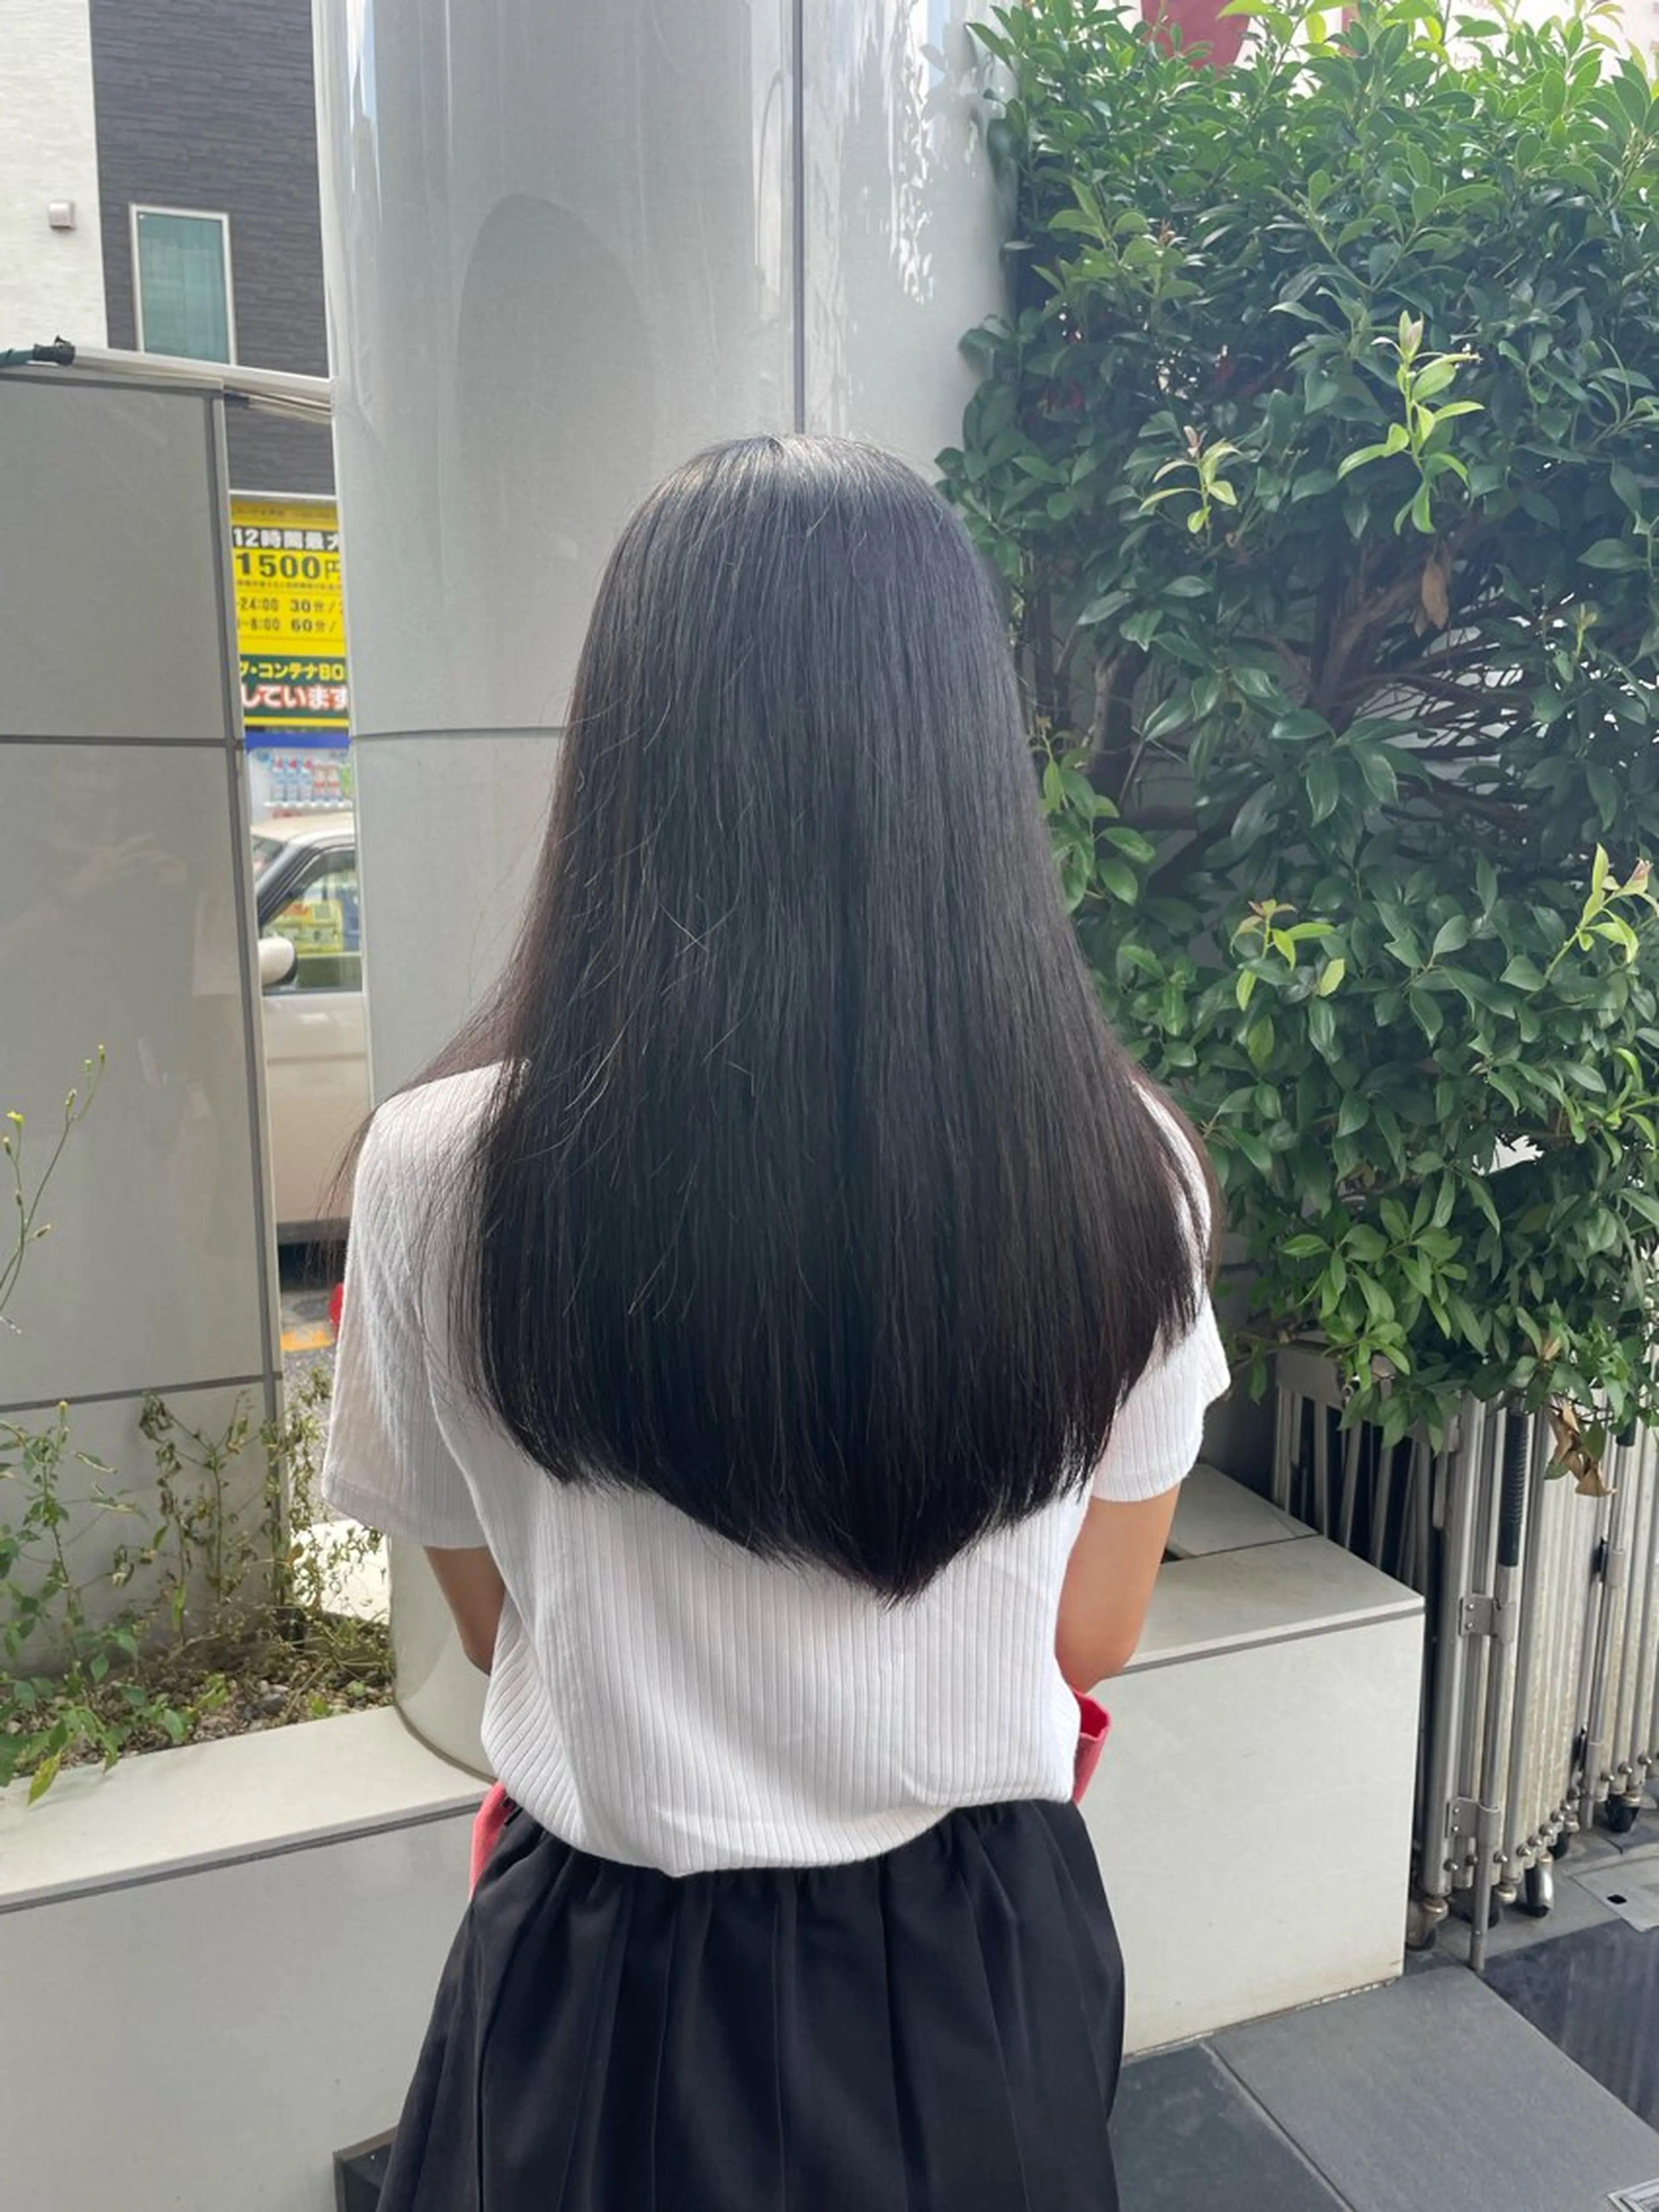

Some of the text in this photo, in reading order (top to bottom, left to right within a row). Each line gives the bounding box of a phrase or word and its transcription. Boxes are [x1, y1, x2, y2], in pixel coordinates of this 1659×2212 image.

[241, 683, 348, 710] しています
